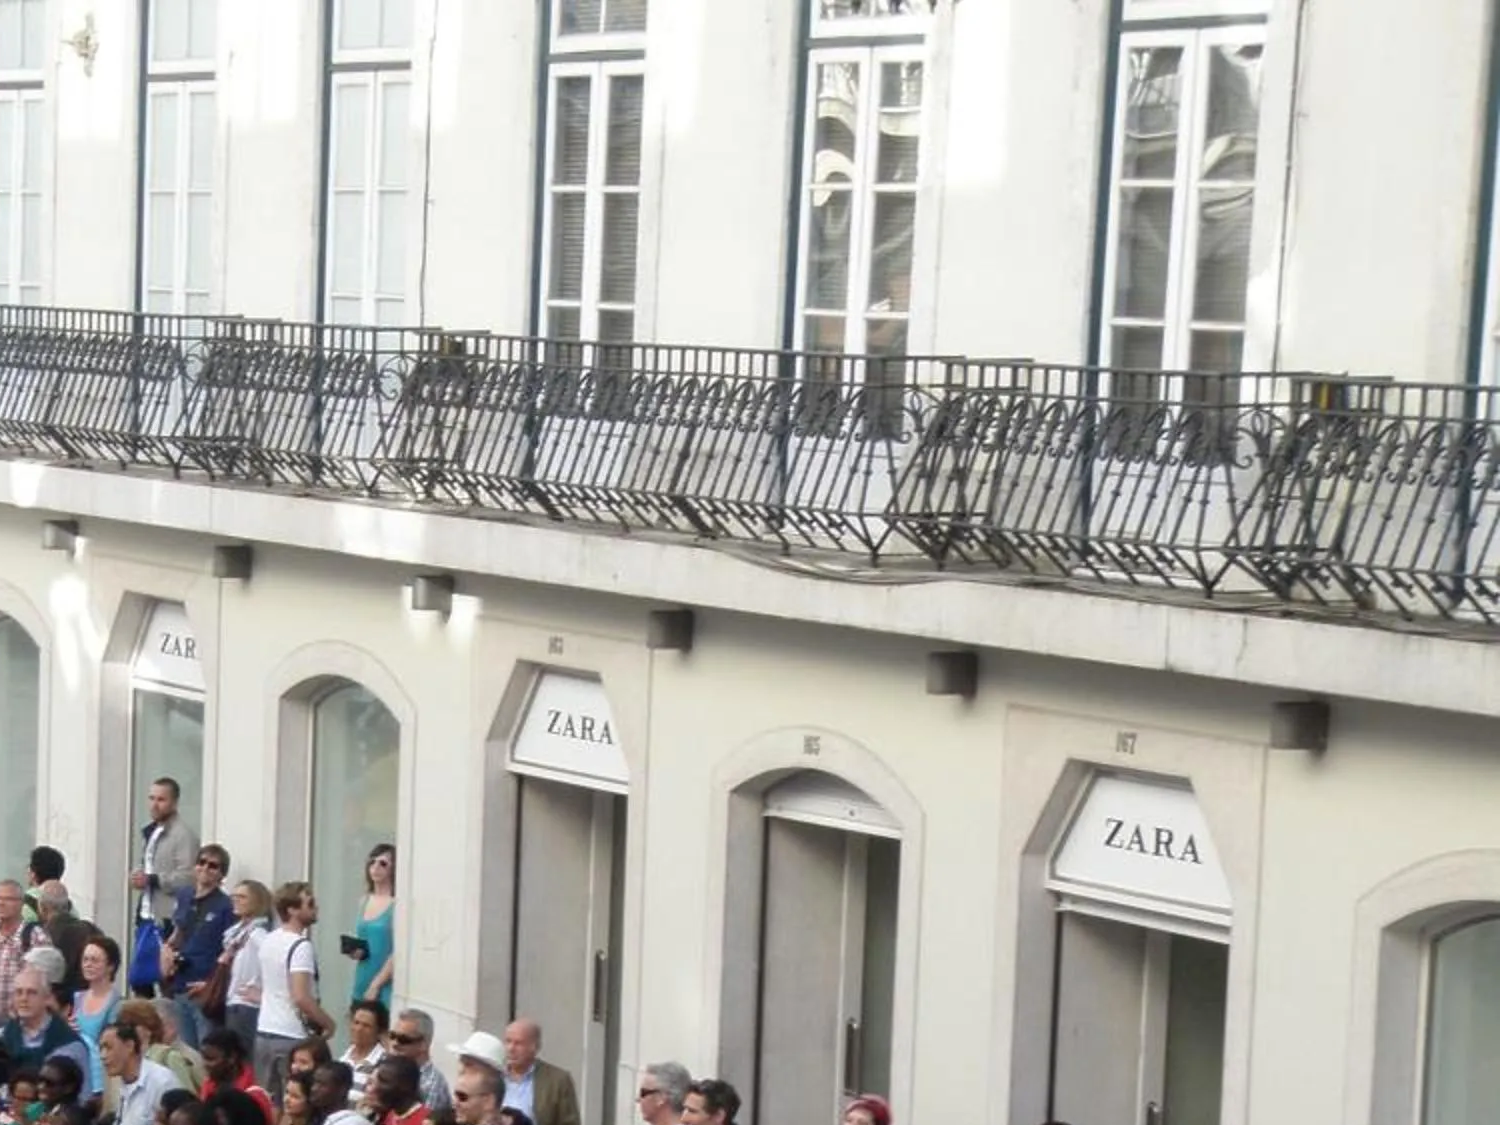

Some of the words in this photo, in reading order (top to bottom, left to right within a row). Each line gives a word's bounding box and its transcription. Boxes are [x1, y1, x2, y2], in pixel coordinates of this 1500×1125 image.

[160, 631, 201, 660] ZAR
[547, 708, 615, 746] ZARA
[1104, 817, 1203, 865] ZARA
